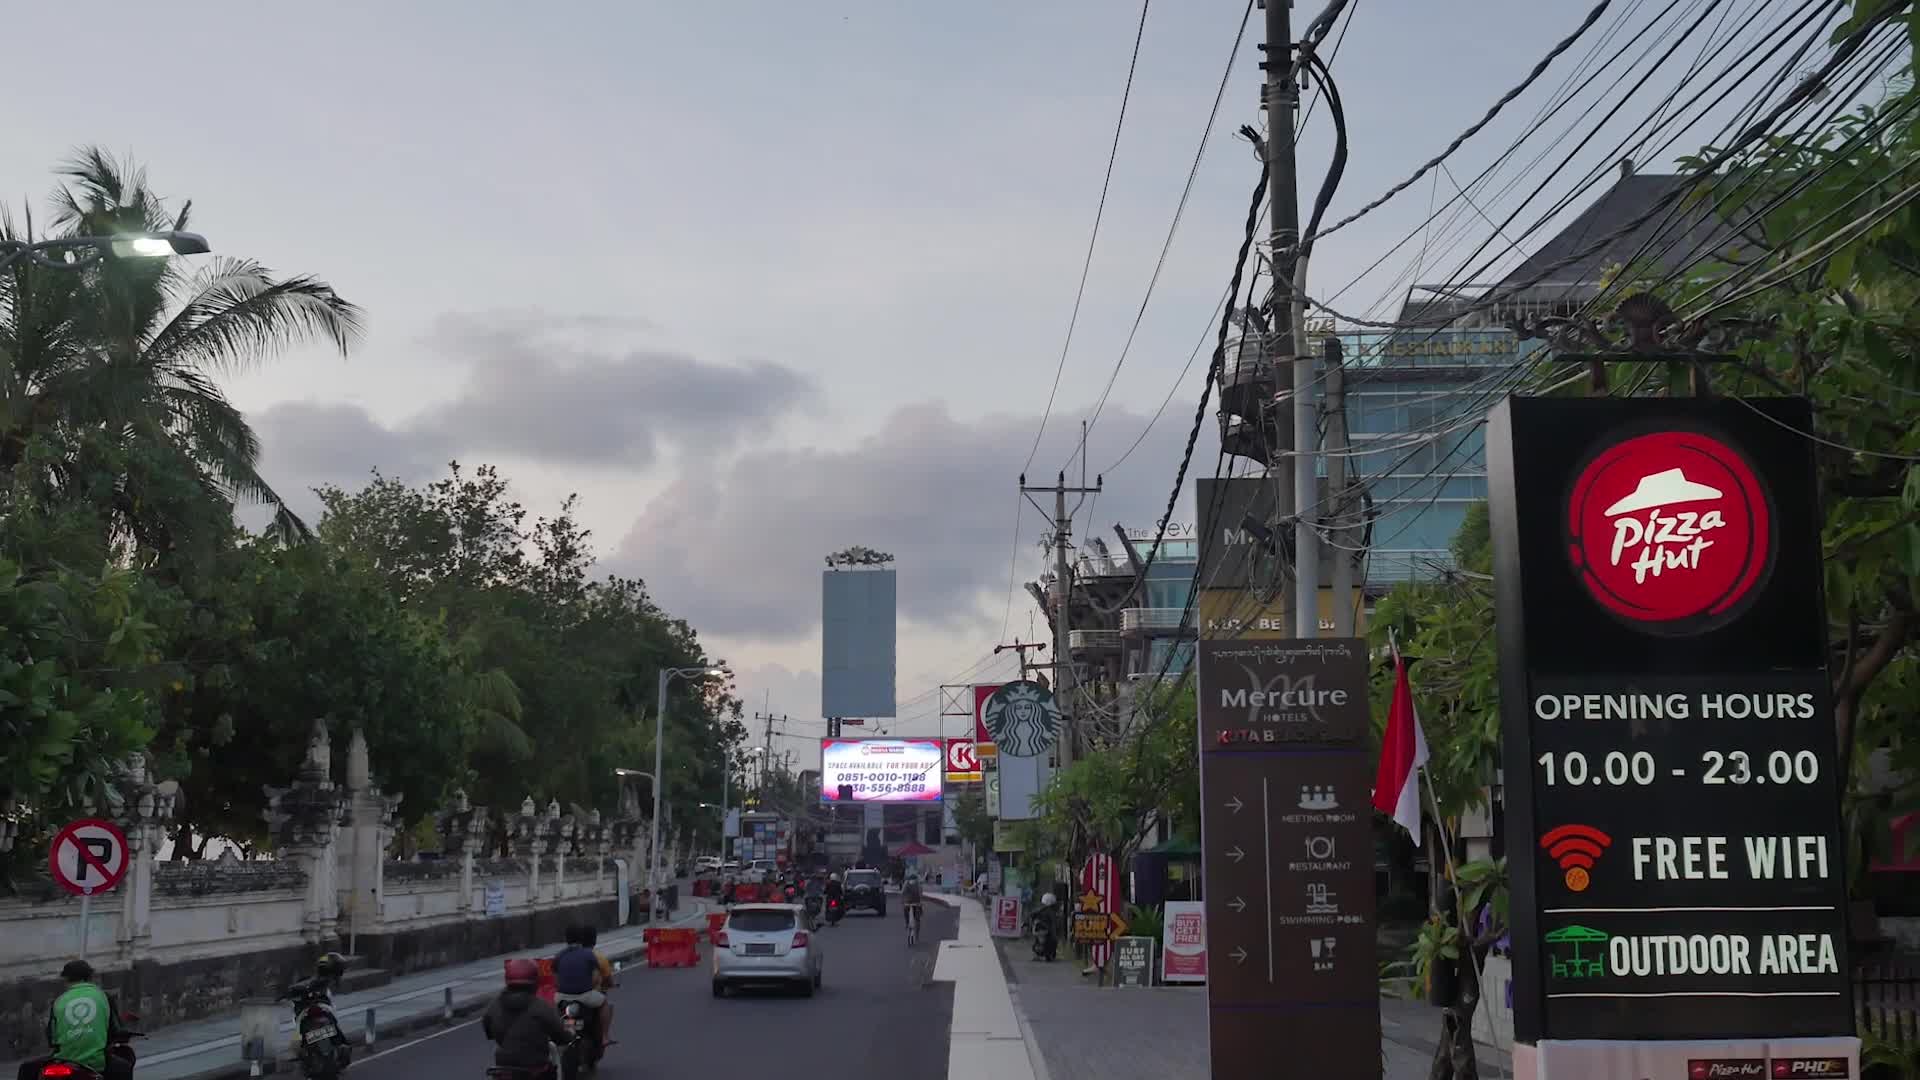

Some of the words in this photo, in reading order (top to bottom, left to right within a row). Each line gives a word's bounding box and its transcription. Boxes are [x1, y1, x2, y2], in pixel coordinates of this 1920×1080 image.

[1611, 509, 1726, 566] Pizza
[1631, 537, 1715, 584] Hut
[1221, 688, 1348, 708] Mercure
[1535, 694, 1689, 720] OPENING
[1701, 693, 1815, 720] HOURS
[1263, 713, 1308, 723] HOTELS
[1538, 751, 1655, 786] 10.00
[1702, 750, 1819, 785] 23.00
[838, 783, 926, 793] 38-556-8888
[1282, 815, 1324, 823] MEETING
[1326, 814, 1355, 822] ROOM
[76, 837, 113, 881] P
[1632, 837, 1728, 880] FREE
[1744, 836, 1829, 880] WIFI
[1289, 862, 1351, 871] RESTAURANT
[1001, 900, 1015, 915] P
[1280, 916, 1334, 926] SWIMMING
[1337, 915, 1365, 924] POOL
[1176, 927, 1193, 935] GET
[1176, 935, 1200, 943] FREE
[1610, 934, 1752, 977] OUTDOOR
[1759, 933, 1839, 975] AREA
[1314, 962, 1334, 970] BAR
[1709, 1064, 1740, 1077] Pizza
[1741, 1063, 1762, 1075] Hut
